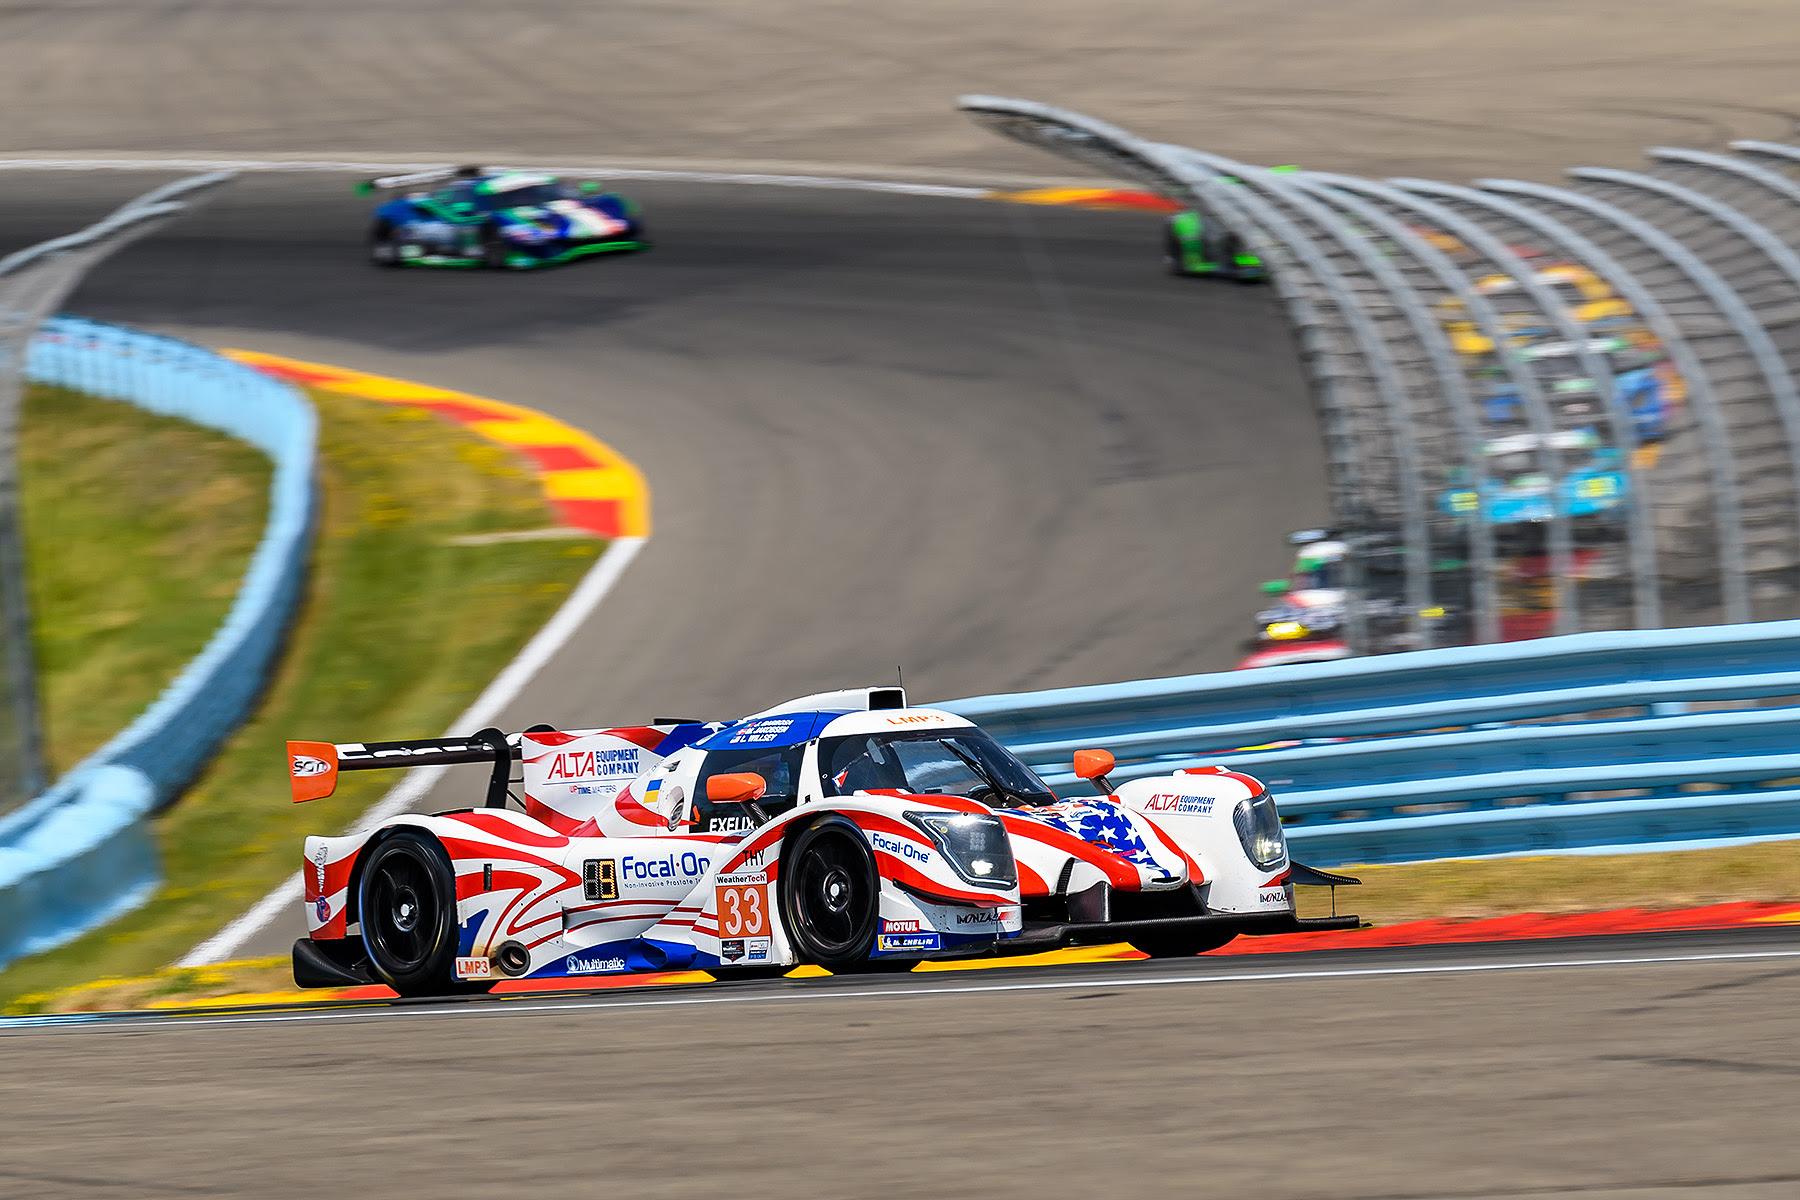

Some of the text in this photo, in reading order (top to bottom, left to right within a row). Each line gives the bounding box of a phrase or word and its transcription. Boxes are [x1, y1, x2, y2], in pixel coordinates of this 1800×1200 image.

[595, 748, 639, 763] EQUIPMENT
[547, 751, 595, 779] ALTA
[596, 761, 640, 776] COMPANY
[1144, 793, 1180, 811] ALTA
[1180, 795, 1215, 805] EQUIPMENT
[1178, 803, 1213, 814] COMPANY
[742, 849, 765, 866] THY
[666, 879, 693, 887] Prostate
[716, 874, 766, 884] WeatherTech
[723, 887, 763, 936] 33
[885, 921, 918, 932] MOTUL
[457, 960, 489, 975] LMP3
[578, 956, 625, 971] Multimatic
